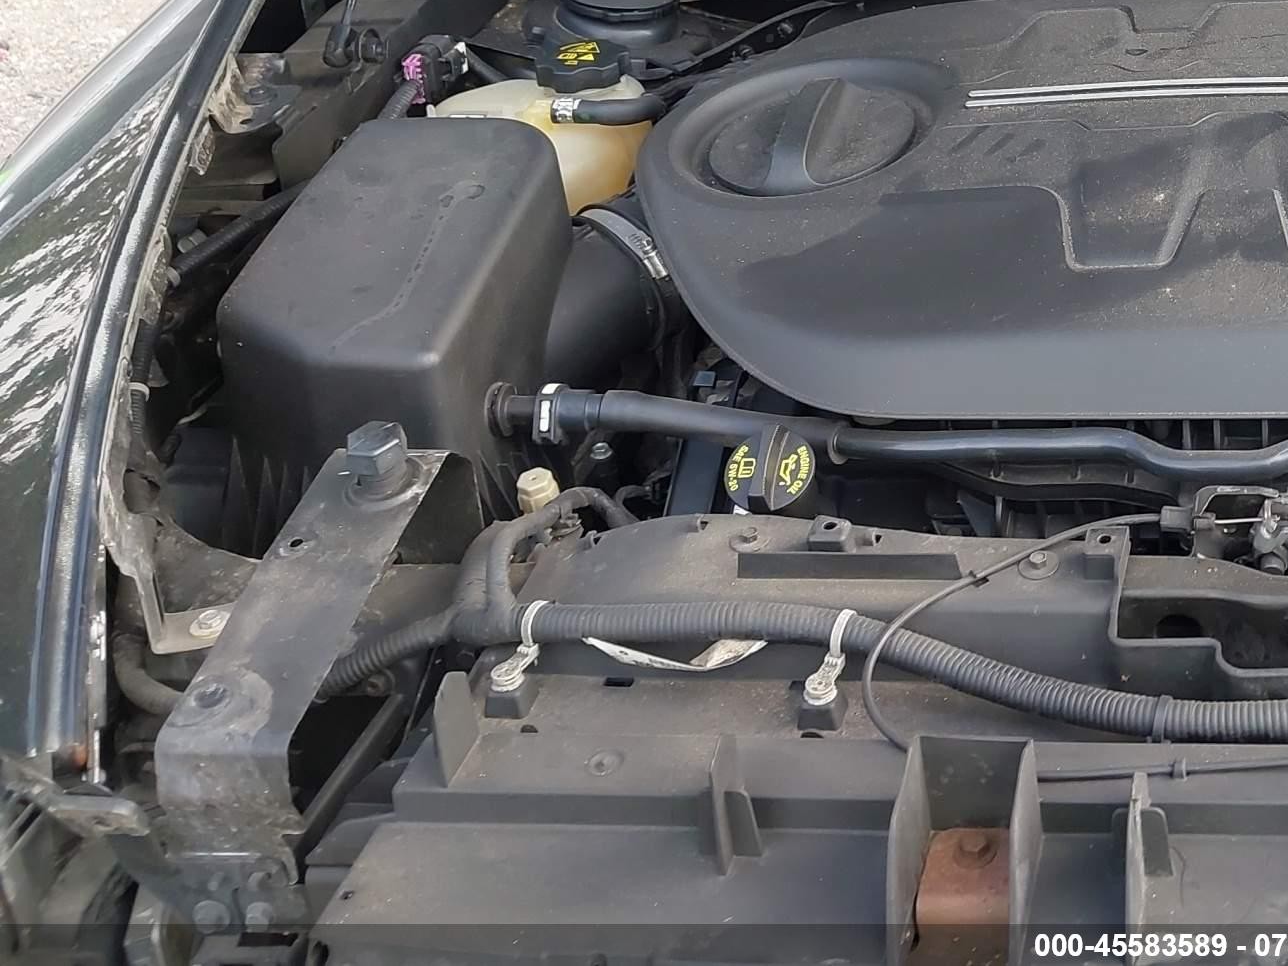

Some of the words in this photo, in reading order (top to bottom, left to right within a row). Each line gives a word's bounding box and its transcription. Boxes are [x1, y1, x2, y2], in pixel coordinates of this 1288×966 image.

[732, 444, 749, 462] SAE
[797, 445, 810, 479] ENGINE
[787, 480, 803, 495] OIL
